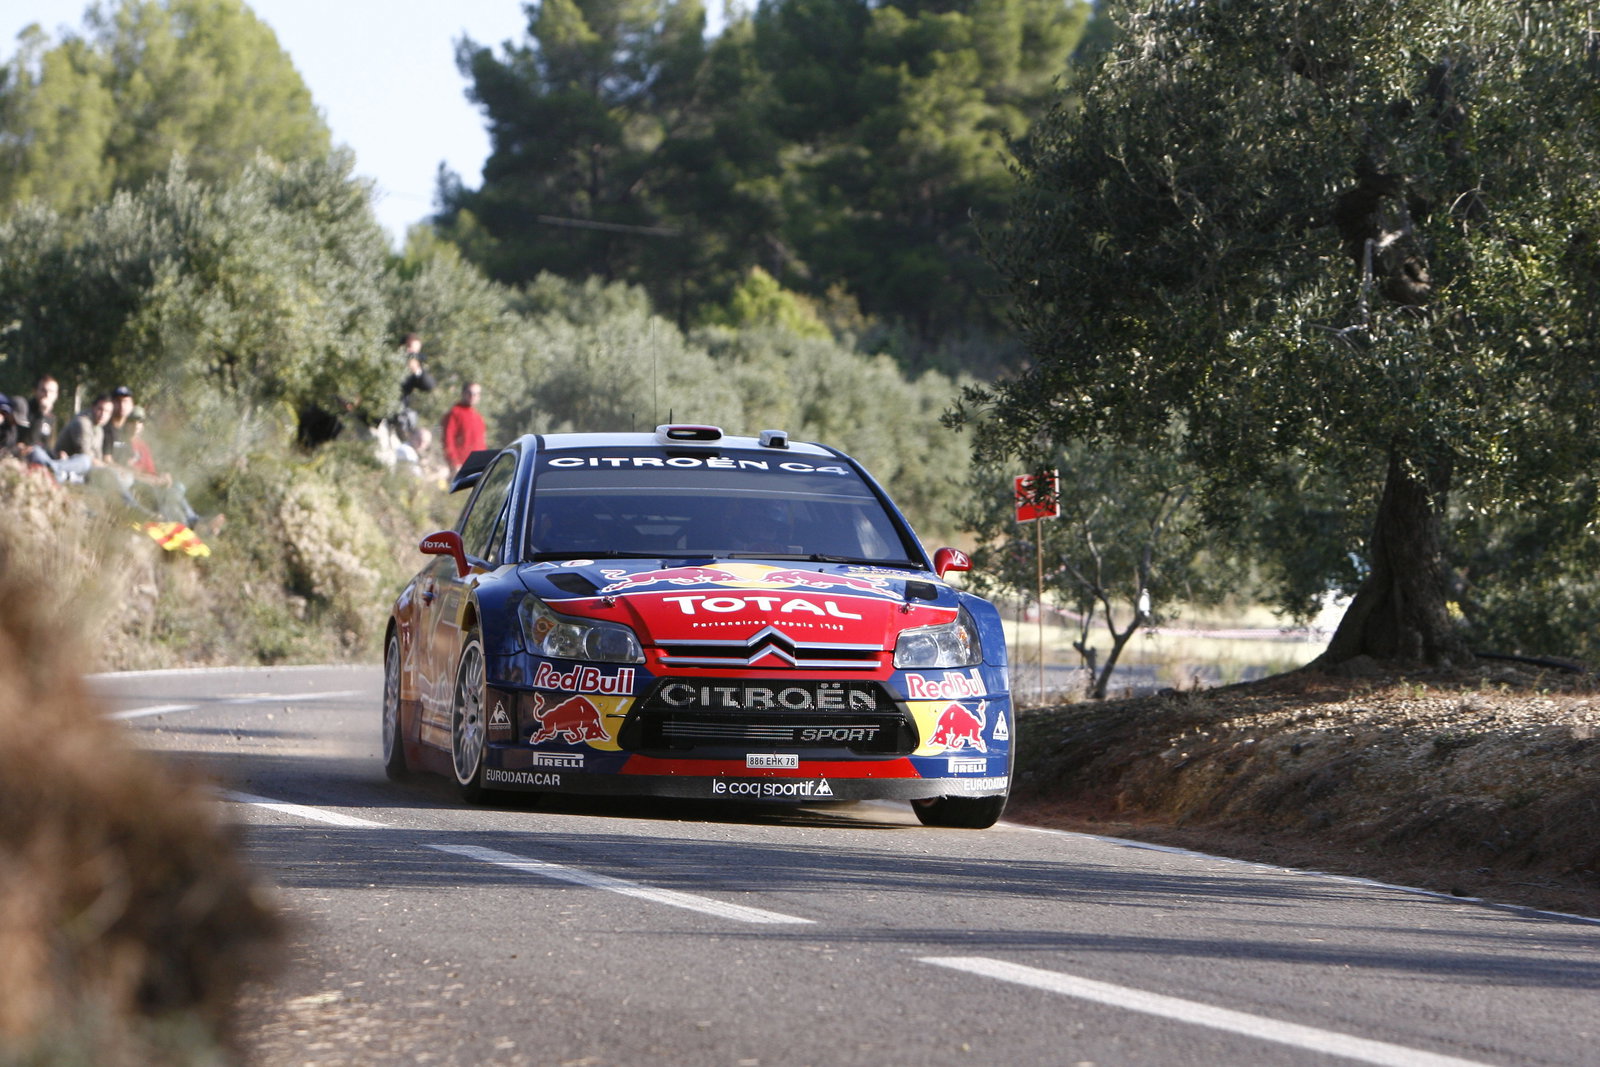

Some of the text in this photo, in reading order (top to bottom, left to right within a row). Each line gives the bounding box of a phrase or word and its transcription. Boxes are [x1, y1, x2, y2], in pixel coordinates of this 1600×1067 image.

[549, 456, 849, 475] CITROËN C4
[424, 541, 452, 549] TOTAL
[662, 595, 862, 620] TOTAL
[773, 619, 814, 628] depuis
[532, 661, 636, 695] Red Bull
[660, 683, 877, 711] CITROËN
[800, 728, 881, 741] SPORT
[532, 751, 585, 768] PIRELLI
[749, 756, 796, 766] 886 EHK 78
[948, 757, 987, 773] PIRELLI
[486, 768, 561, 786] EURODATACAR
[712, 778, 815, 798] le coq sportif
